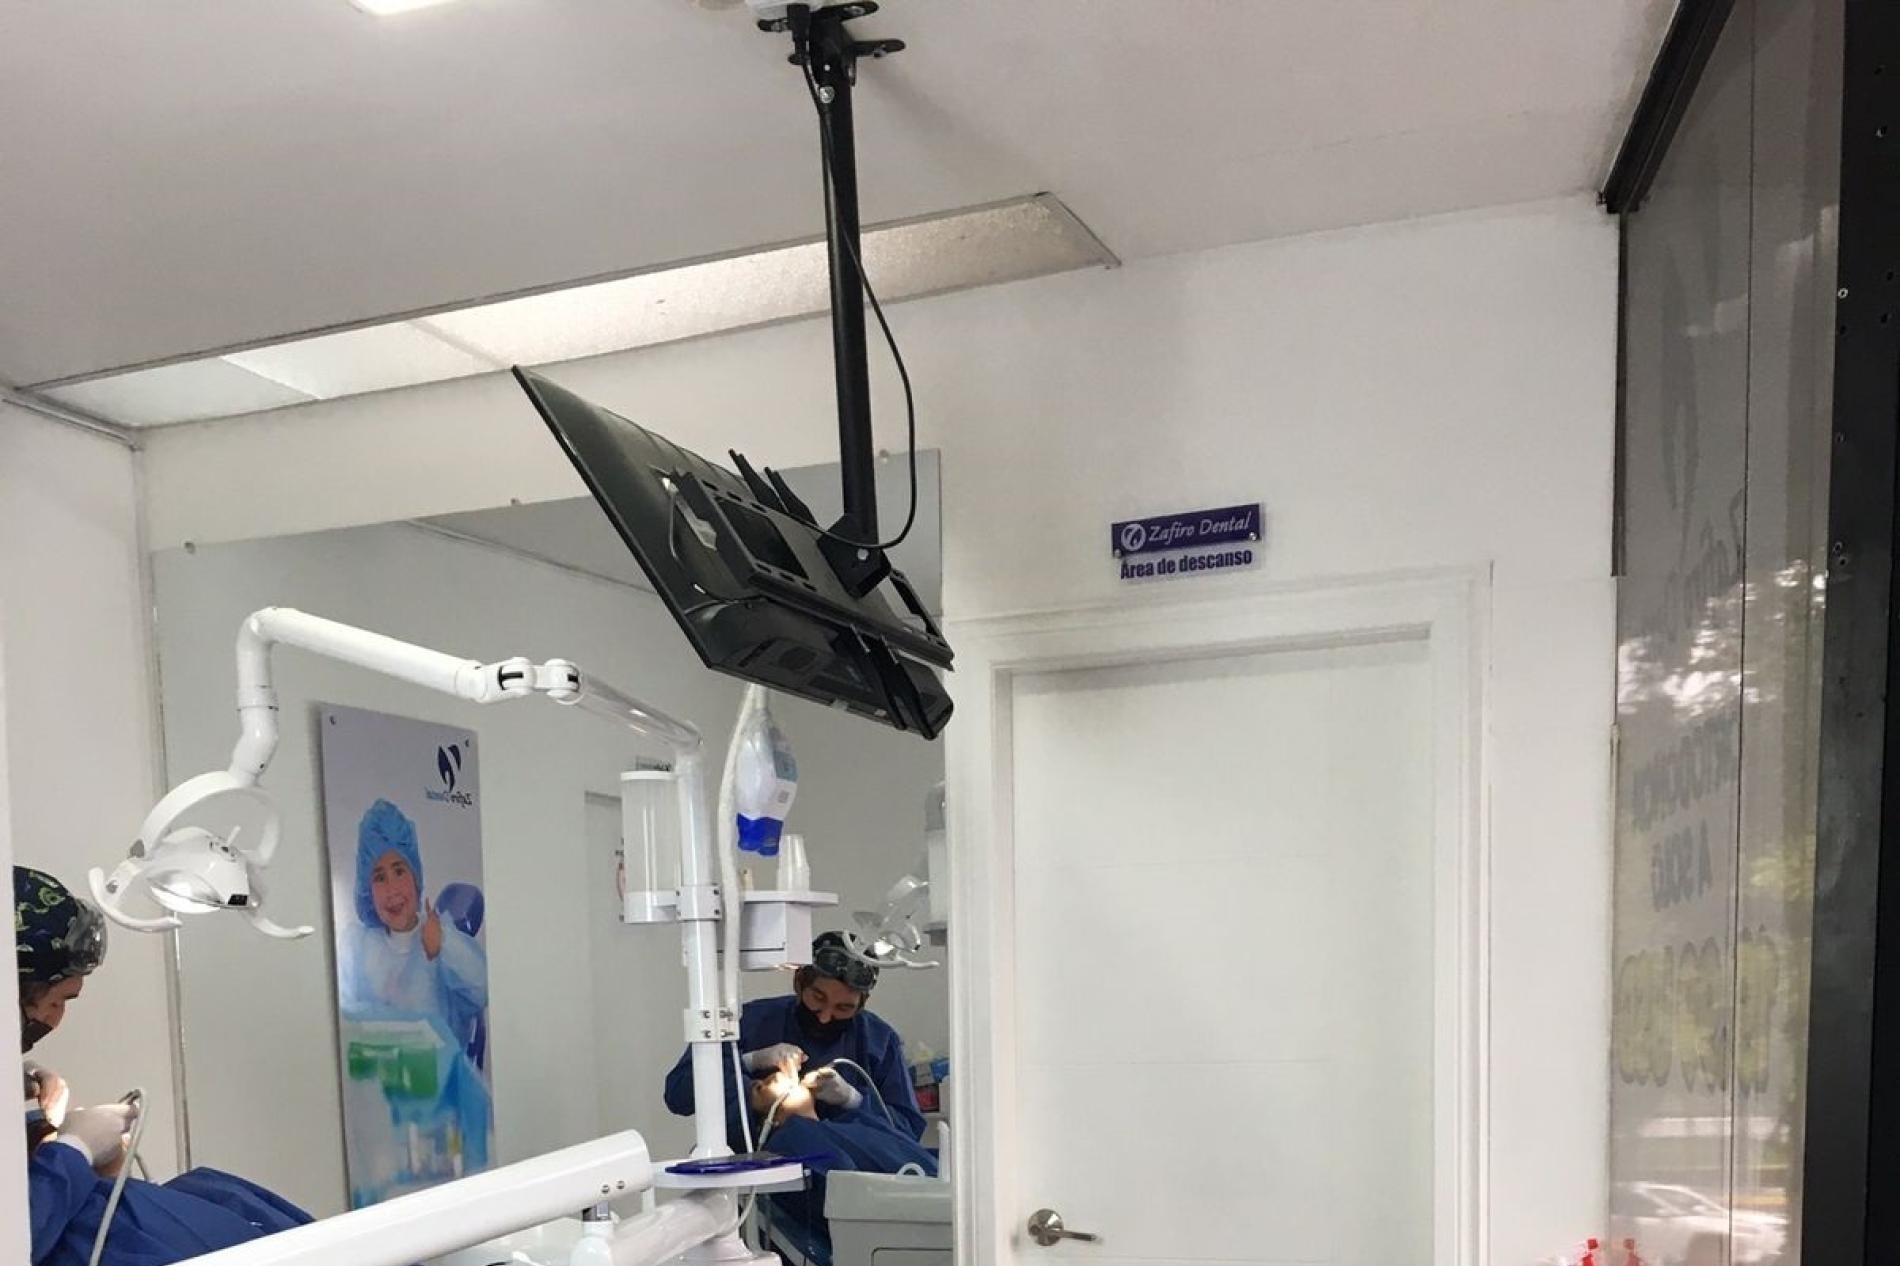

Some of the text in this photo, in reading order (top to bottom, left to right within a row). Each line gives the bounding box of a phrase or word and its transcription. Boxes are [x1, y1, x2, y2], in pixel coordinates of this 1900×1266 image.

[1149, 511, 1251, 545] Zafiro Dental
[1157, 557, 1176, 575] de
[1179, 550, 1253, 573] descanso
